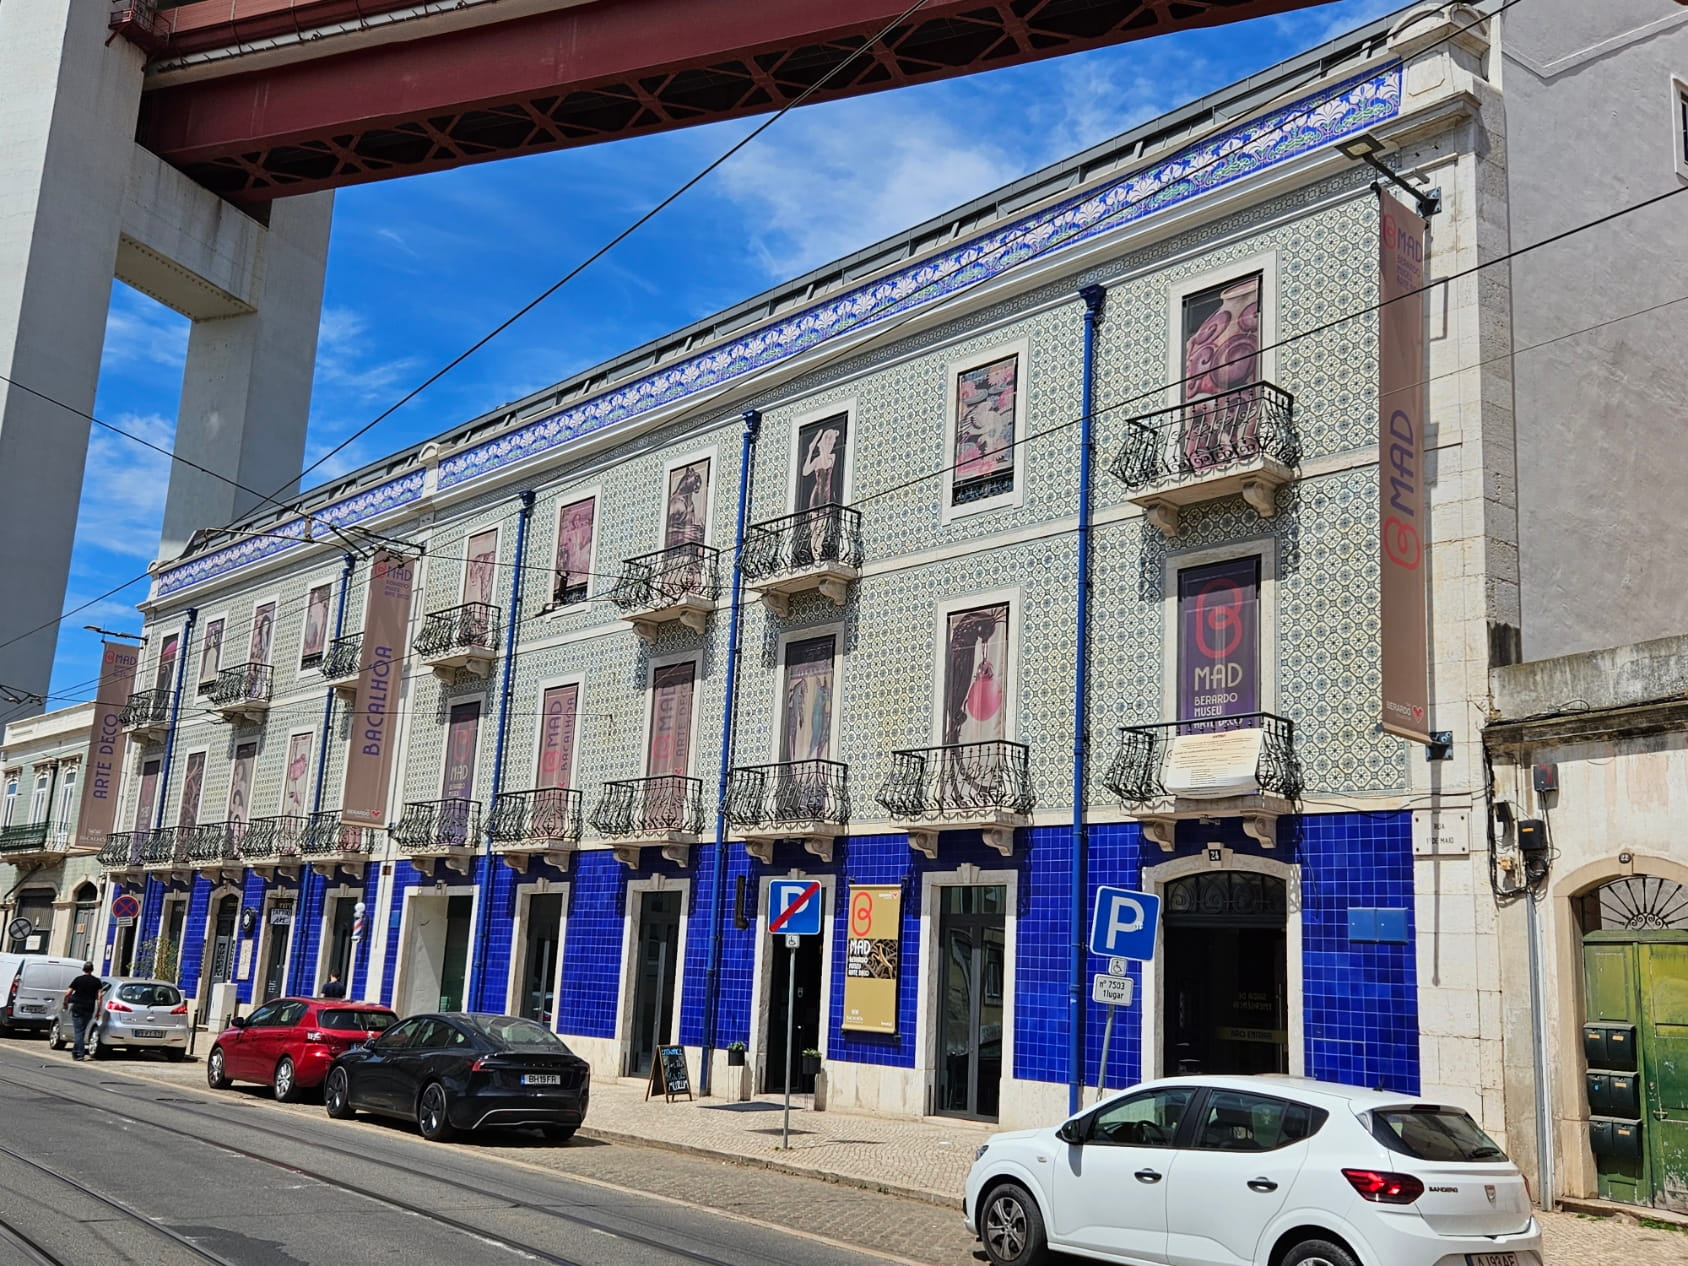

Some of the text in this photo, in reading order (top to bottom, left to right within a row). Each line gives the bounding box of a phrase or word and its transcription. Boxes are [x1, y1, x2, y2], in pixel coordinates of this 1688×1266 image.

[1397, 227, 1422, 262] MAD
[1390, 409, 1414, 517] MAD
[115, 654, 137, 665] MAD
[1194, 662, 1243, 692] MAD
[1194, 692, 1238, 706] BERARDO
[1194, 705, 1222, 718] MUSEU
[547, 700, 563, 748] MAD
[93, 713, 118, 799] ARTE DECO
[450, 764, 469, 781] MAD
[1106, 895, 1145, 949] P
[850, 939, 871, 956] MAD
[1109, 982, 1125, 990] 7503
